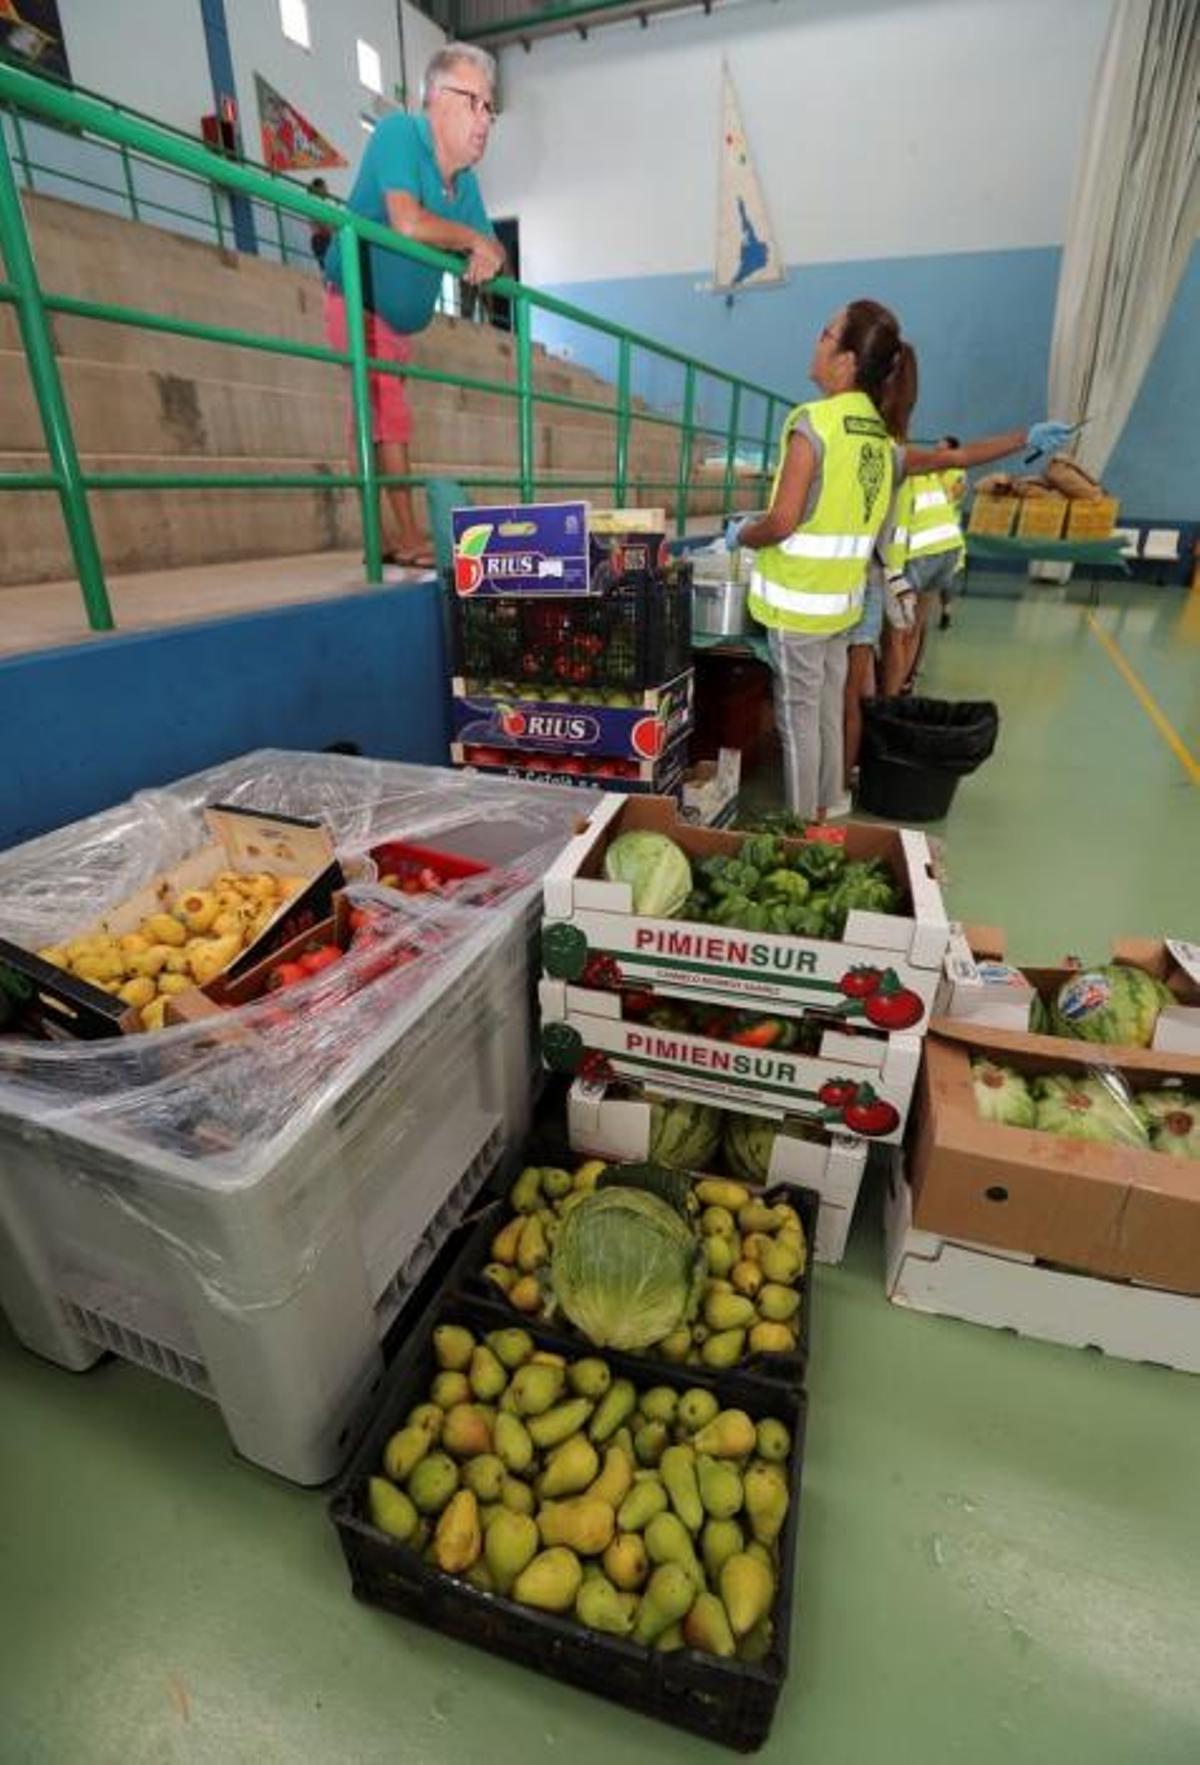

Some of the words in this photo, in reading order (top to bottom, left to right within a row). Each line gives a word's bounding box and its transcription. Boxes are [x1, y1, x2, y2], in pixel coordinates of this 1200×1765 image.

[487, 556, 533, 574] RIUS
[528, 716, 586, 739] RIUS
[635, 928, 818, 973] PIMIENSUR
[625, 1032, 797, 1083] PIMIENSUR
